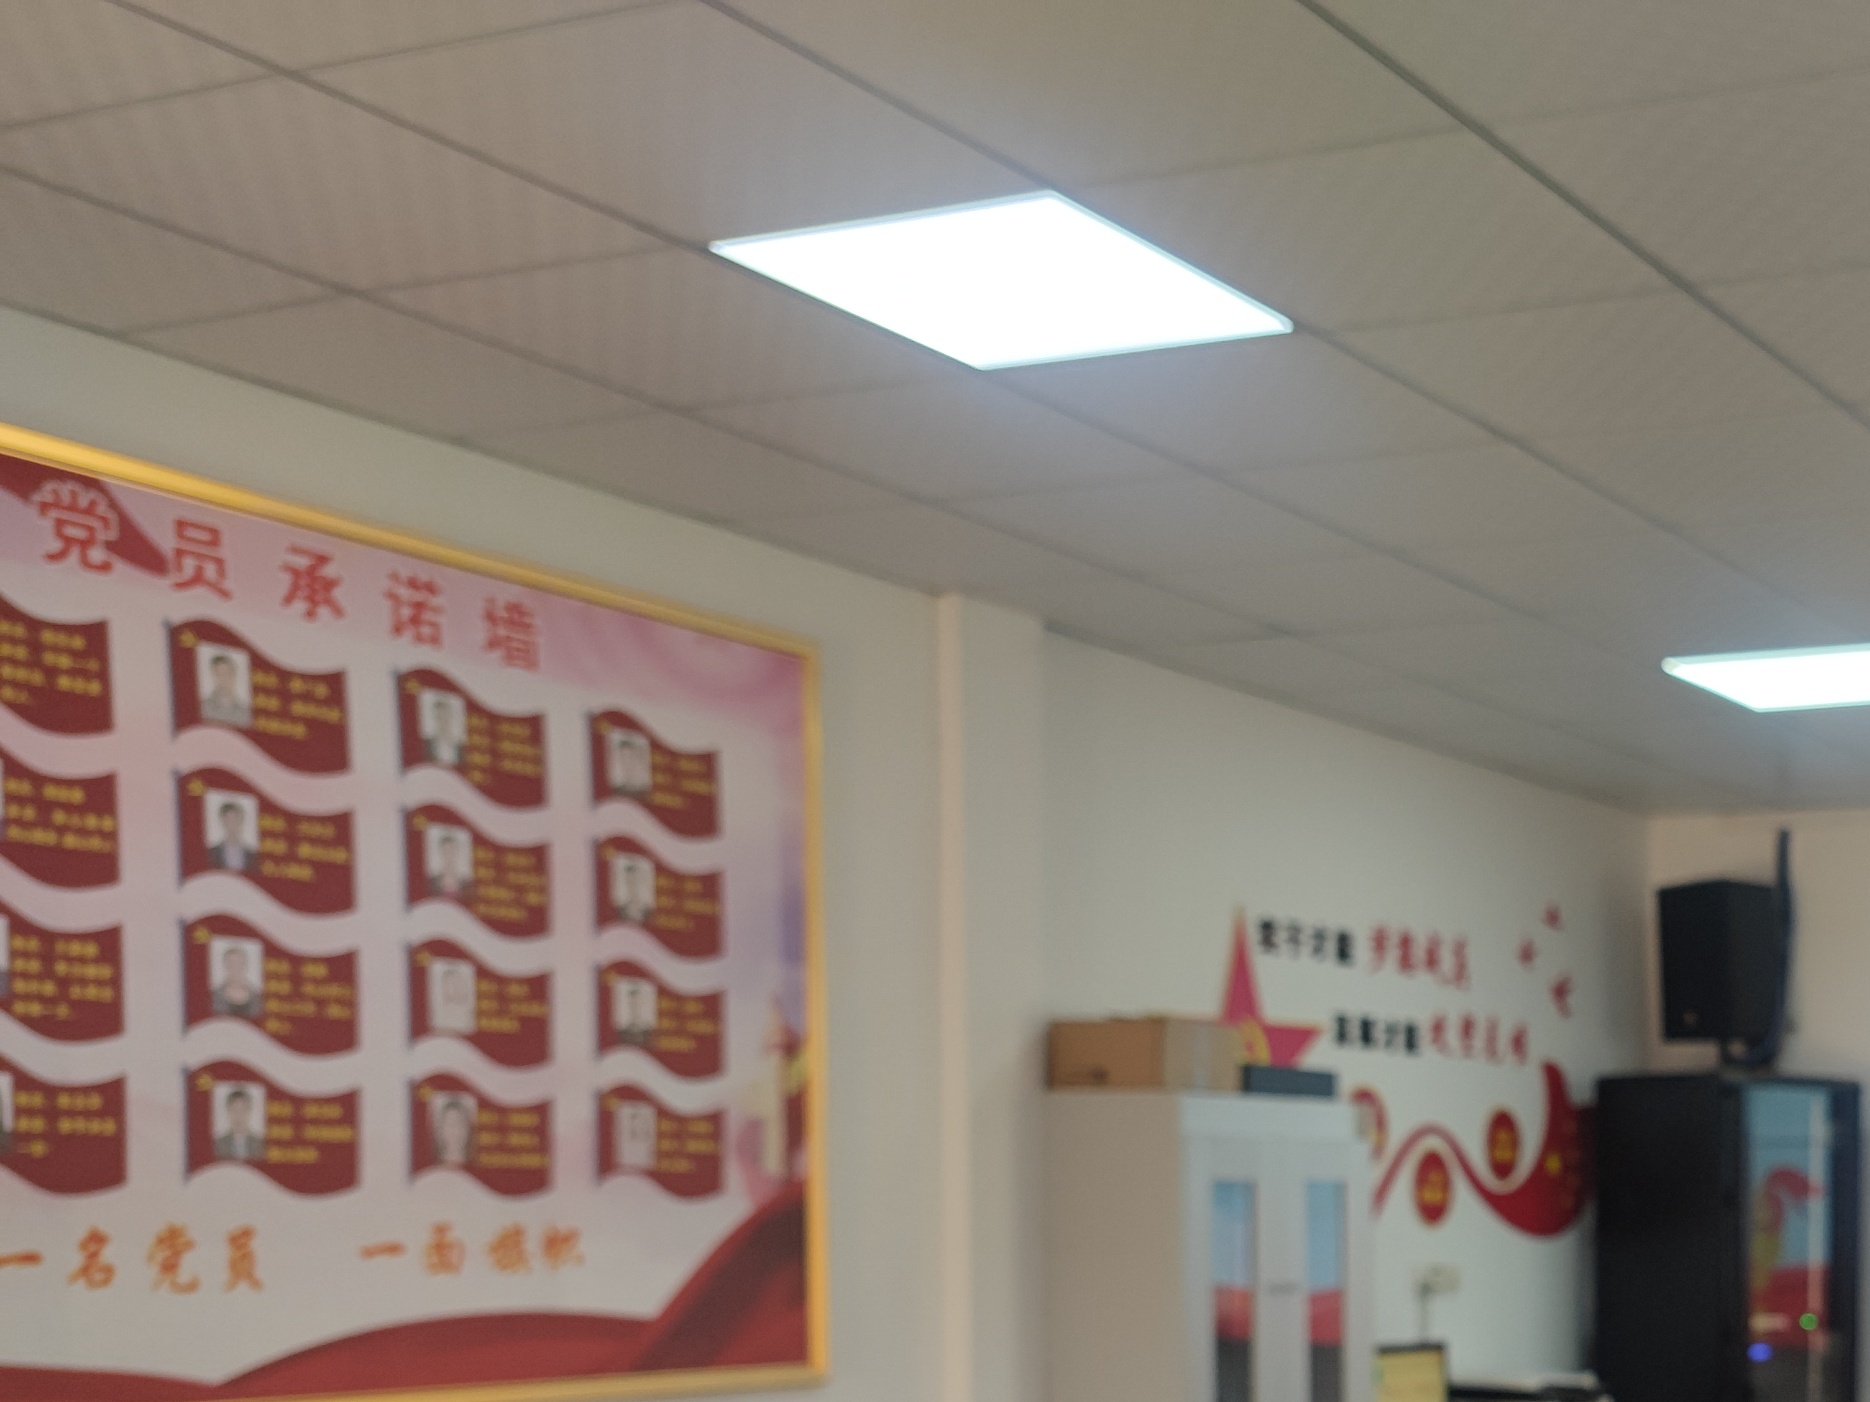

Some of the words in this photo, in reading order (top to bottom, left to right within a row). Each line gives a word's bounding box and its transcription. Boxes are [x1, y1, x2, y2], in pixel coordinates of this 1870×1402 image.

[33, 475, 544, 673] 党员承诺墙
[0, 1223, 264, 1294] 一名党员
